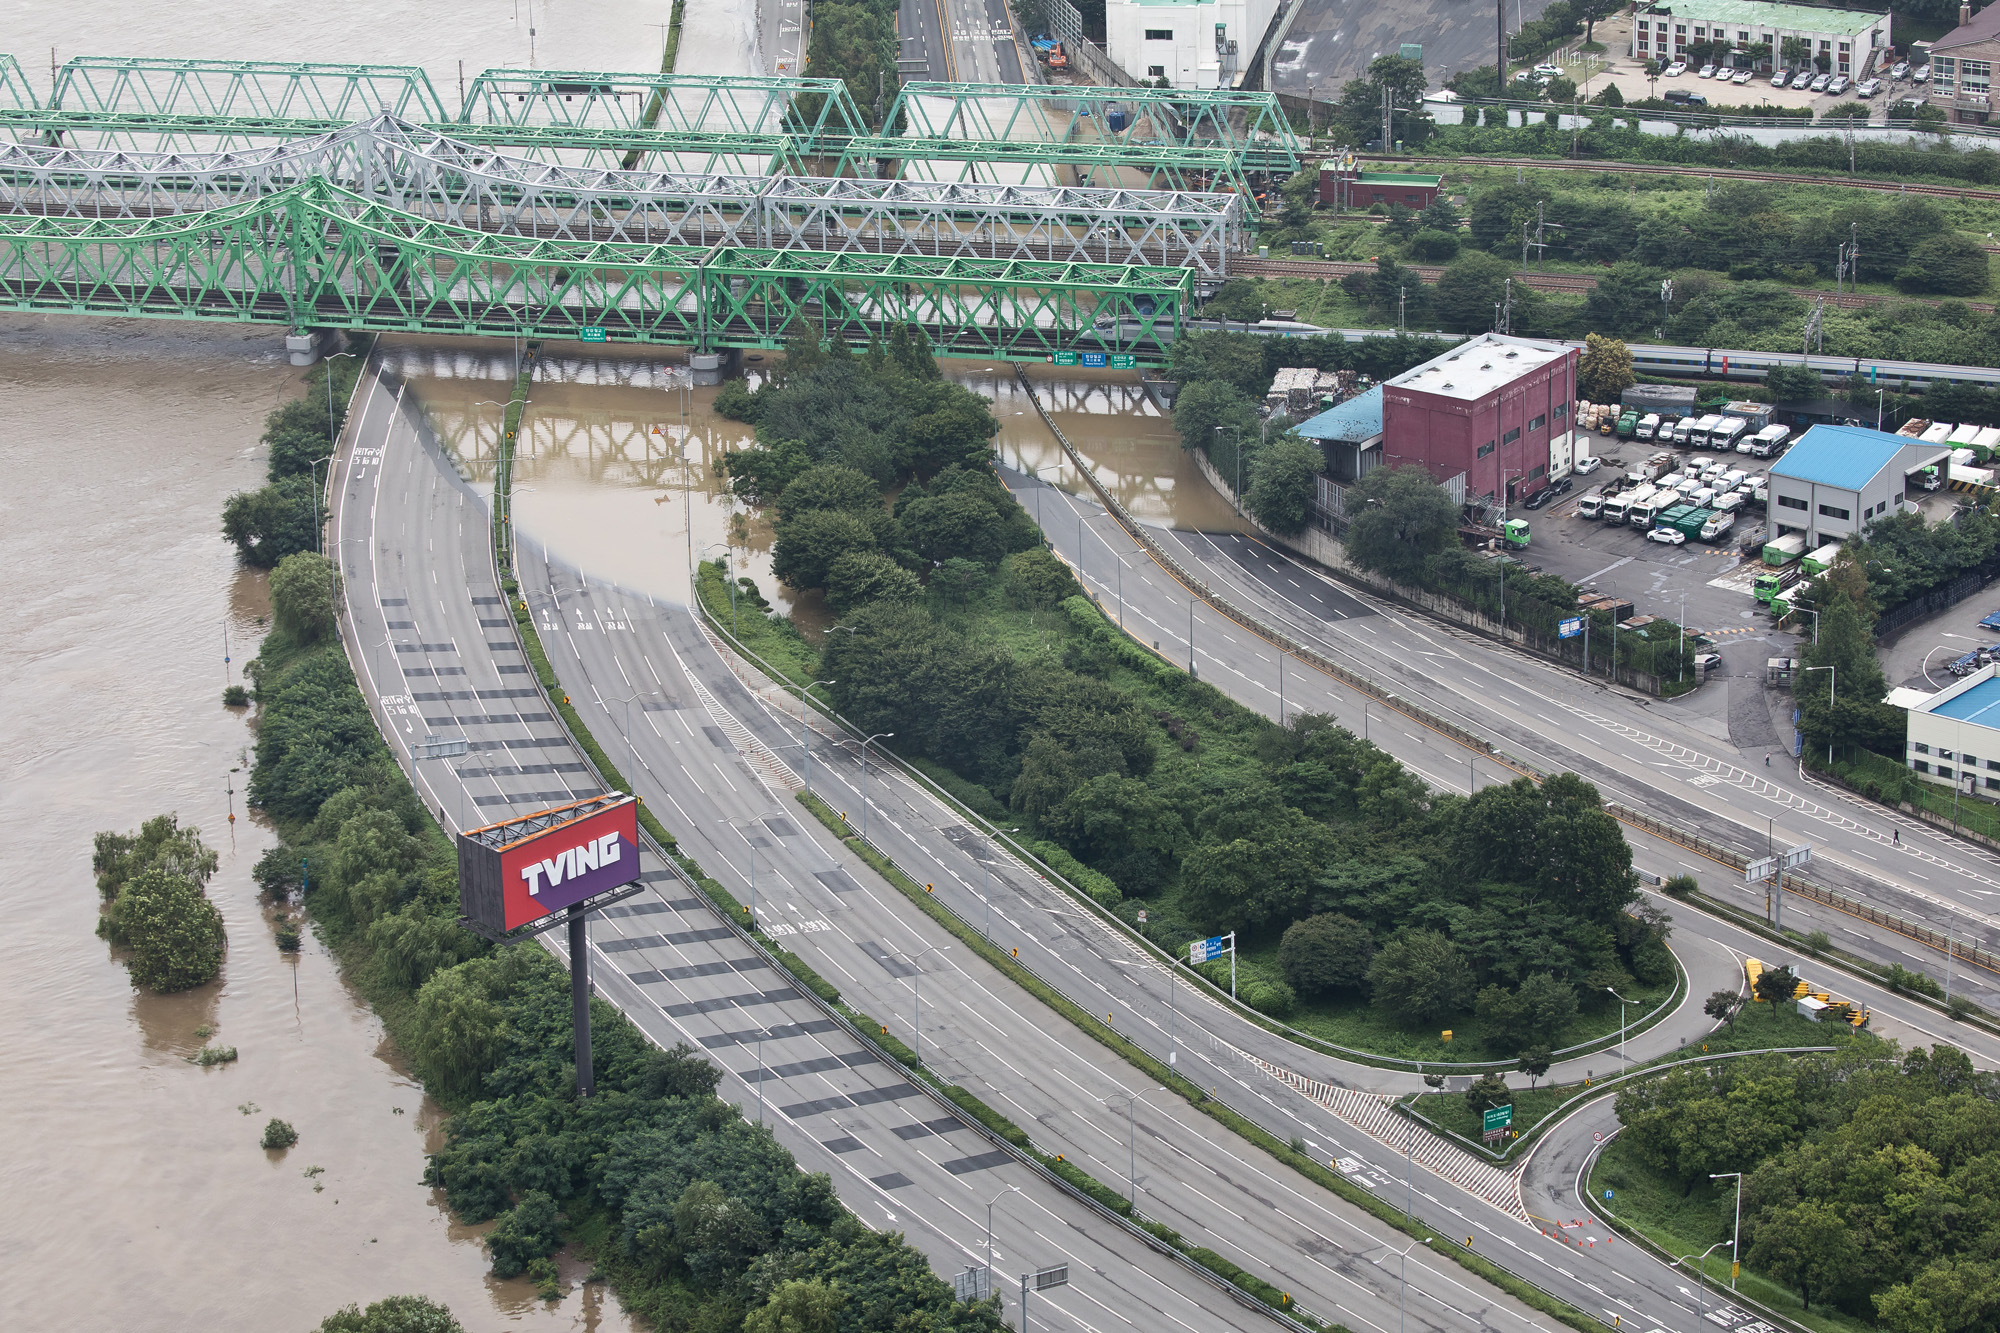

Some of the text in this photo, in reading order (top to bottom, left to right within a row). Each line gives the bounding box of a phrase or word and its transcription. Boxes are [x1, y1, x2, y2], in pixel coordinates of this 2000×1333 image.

[385, 704, 418, 716] 여의도
[521, 831, 621, 896] TVING
[764, 923, 798, 937] 소형차
[798, 919, 832, 933] 소형차
[1704, 1305, 1753, 1327] 여의도
